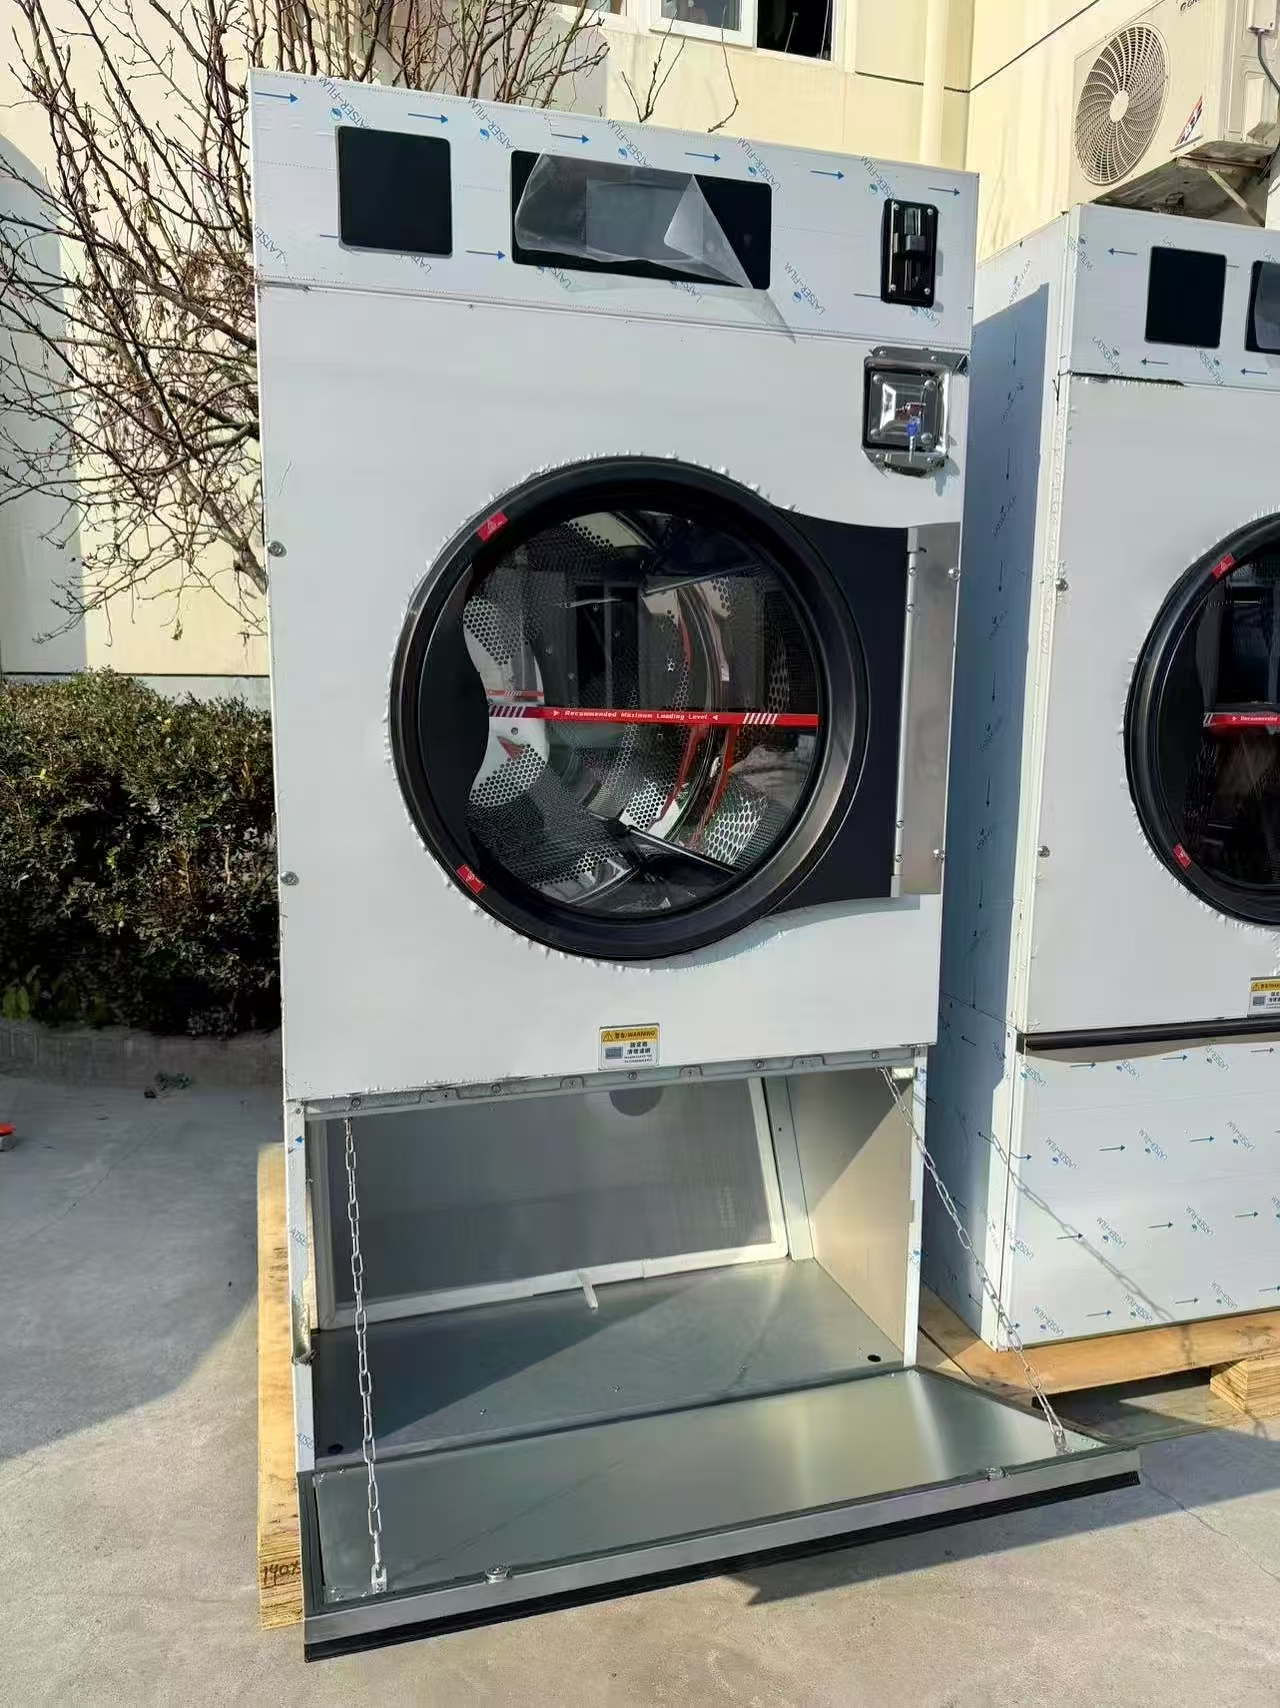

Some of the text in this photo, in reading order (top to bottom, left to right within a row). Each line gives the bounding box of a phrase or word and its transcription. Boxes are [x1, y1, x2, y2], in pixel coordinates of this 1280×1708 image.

[318, 76, 372, 129] ATSER-FILM
[737, 137, 782, 192] LATSER-FILM
[784, 261, 826, 316] LATSER-FILM
[564, 710, 617, 718] Recommended
[620, 711, 653, 719] Maximum
[656, 712, 685, 720] Loading
